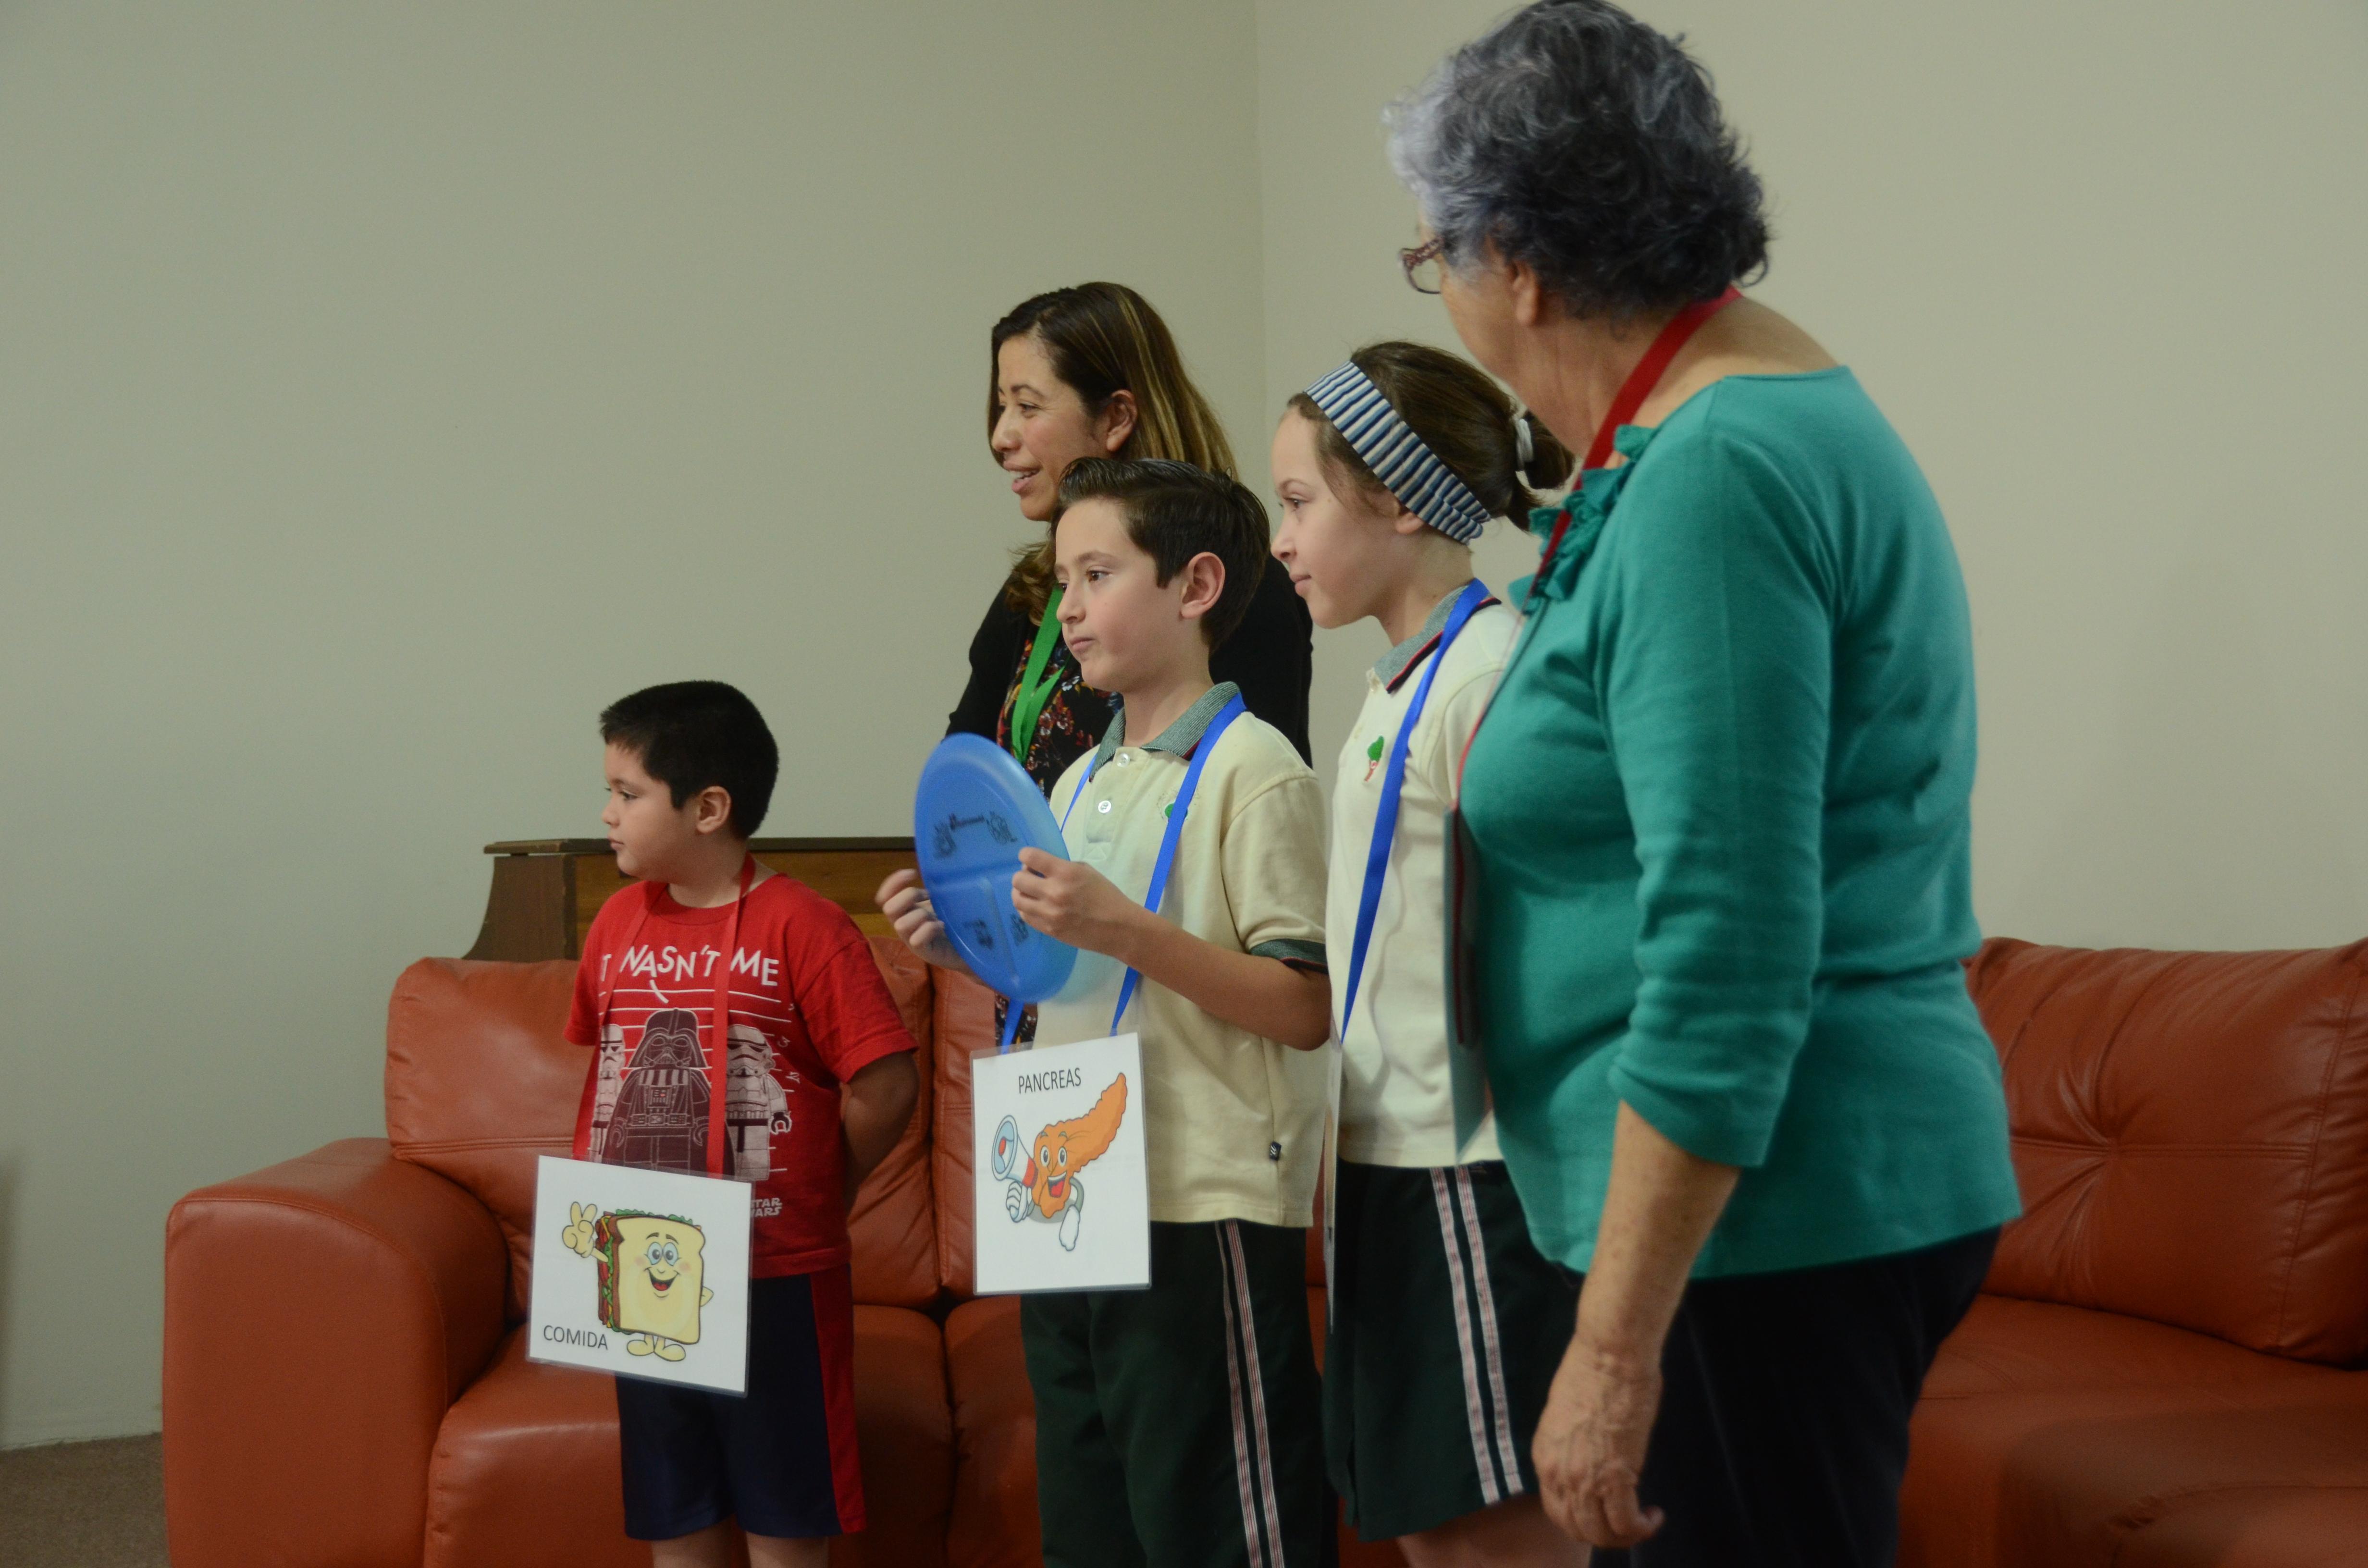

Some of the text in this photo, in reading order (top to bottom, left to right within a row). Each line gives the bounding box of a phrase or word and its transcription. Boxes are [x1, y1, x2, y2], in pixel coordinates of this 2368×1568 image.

[730, 946, 779, 986] ME
[1018, 1067, 1082, 1094] PANCREAS
[751, 1206, 782, 1218] ARS
[543, 1324, 608, 1350] COMIDA
